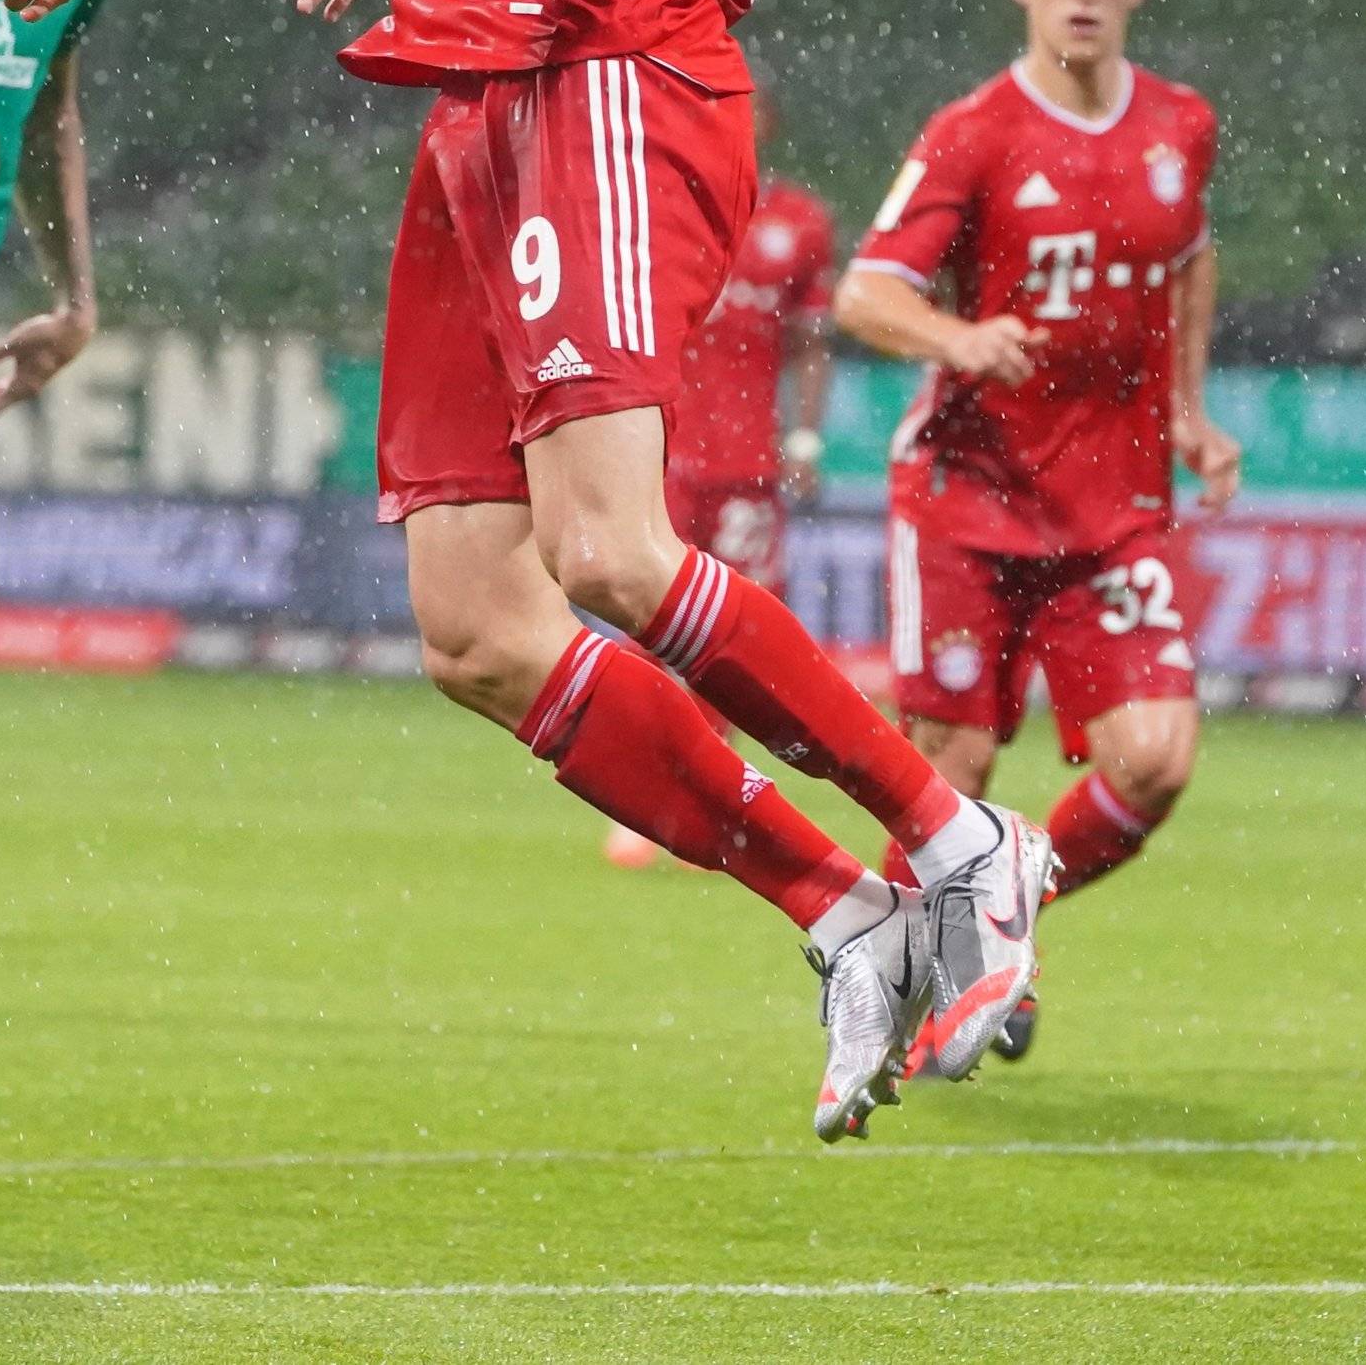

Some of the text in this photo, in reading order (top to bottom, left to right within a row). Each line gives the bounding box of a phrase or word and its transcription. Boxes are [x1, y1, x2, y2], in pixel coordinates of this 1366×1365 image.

[511, 216, 561, 321] 9
[537, 362, 593, 382] adidas
[1091, 557, 1183, 635] 32
